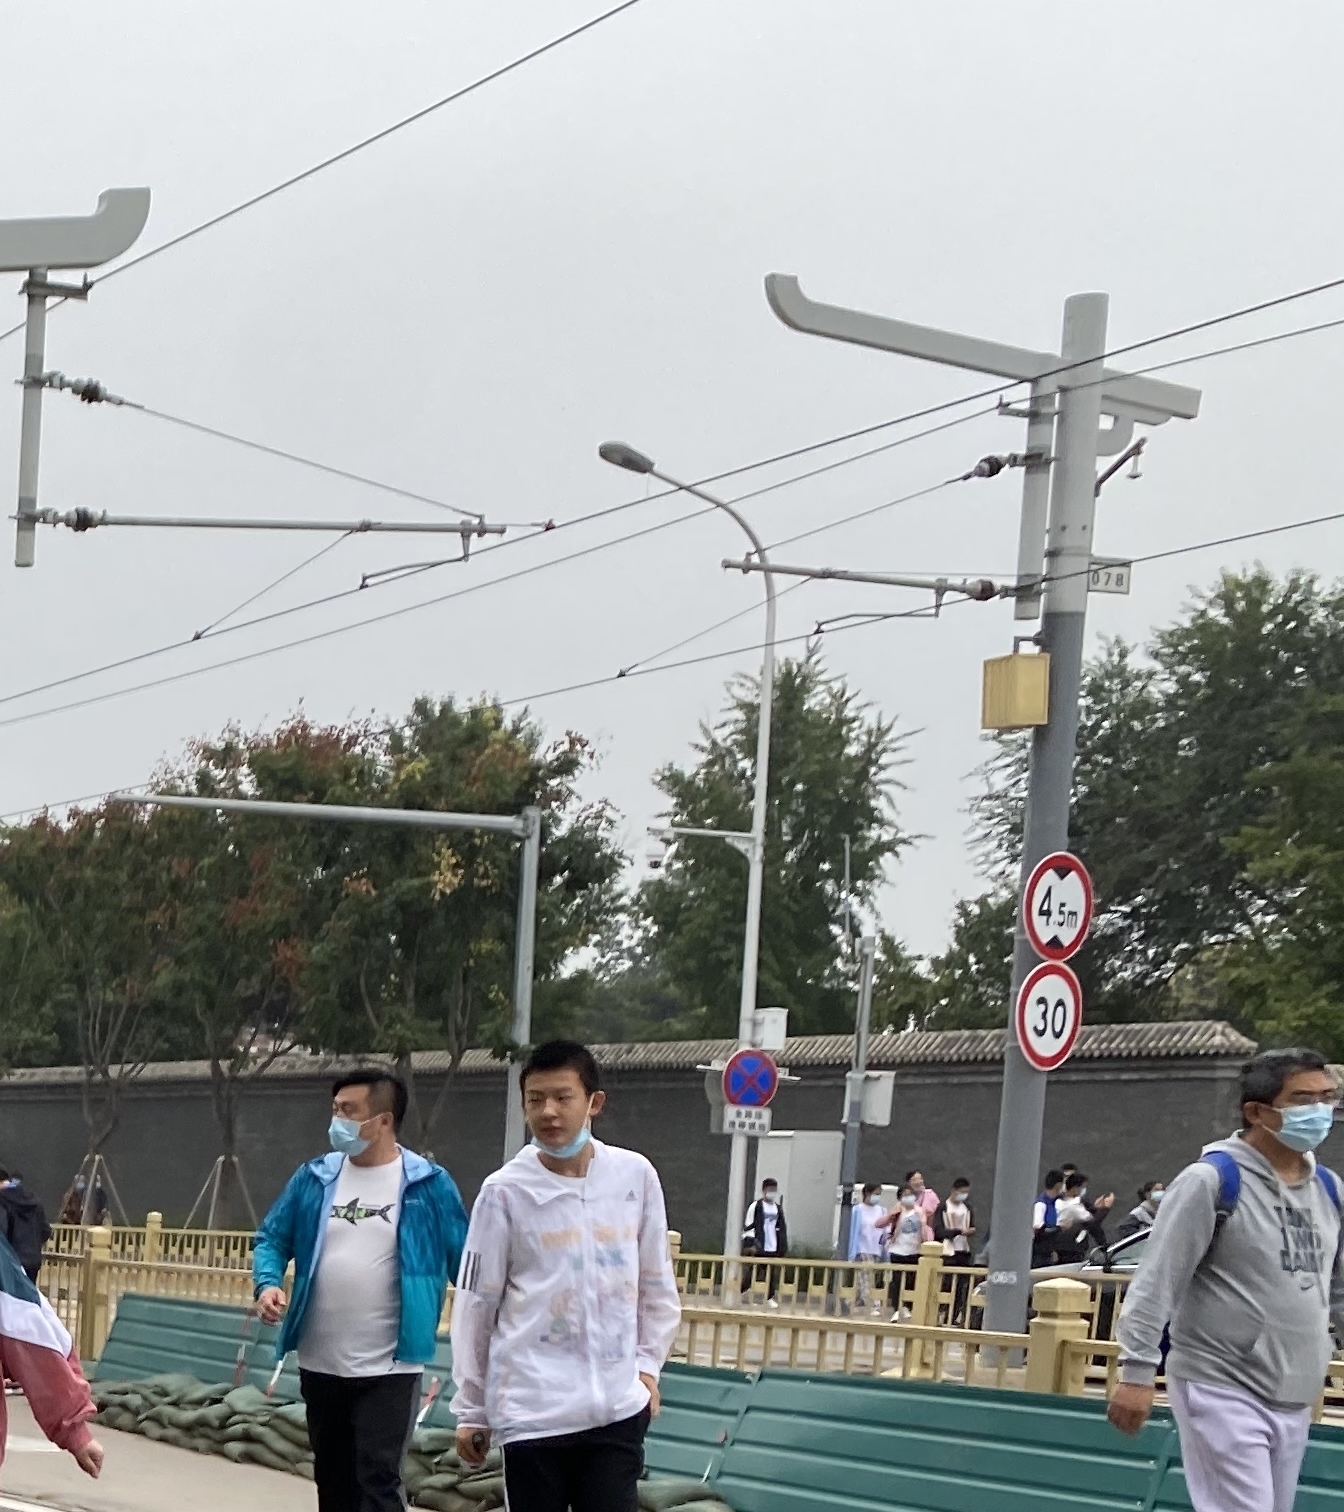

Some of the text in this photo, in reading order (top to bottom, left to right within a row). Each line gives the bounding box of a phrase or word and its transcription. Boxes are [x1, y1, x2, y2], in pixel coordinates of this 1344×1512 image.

[1092, 570, 1124, 587] 078
[1037, 885, 1078, 929] 4.5m
[1032, 996, 1067, 1040] 30
